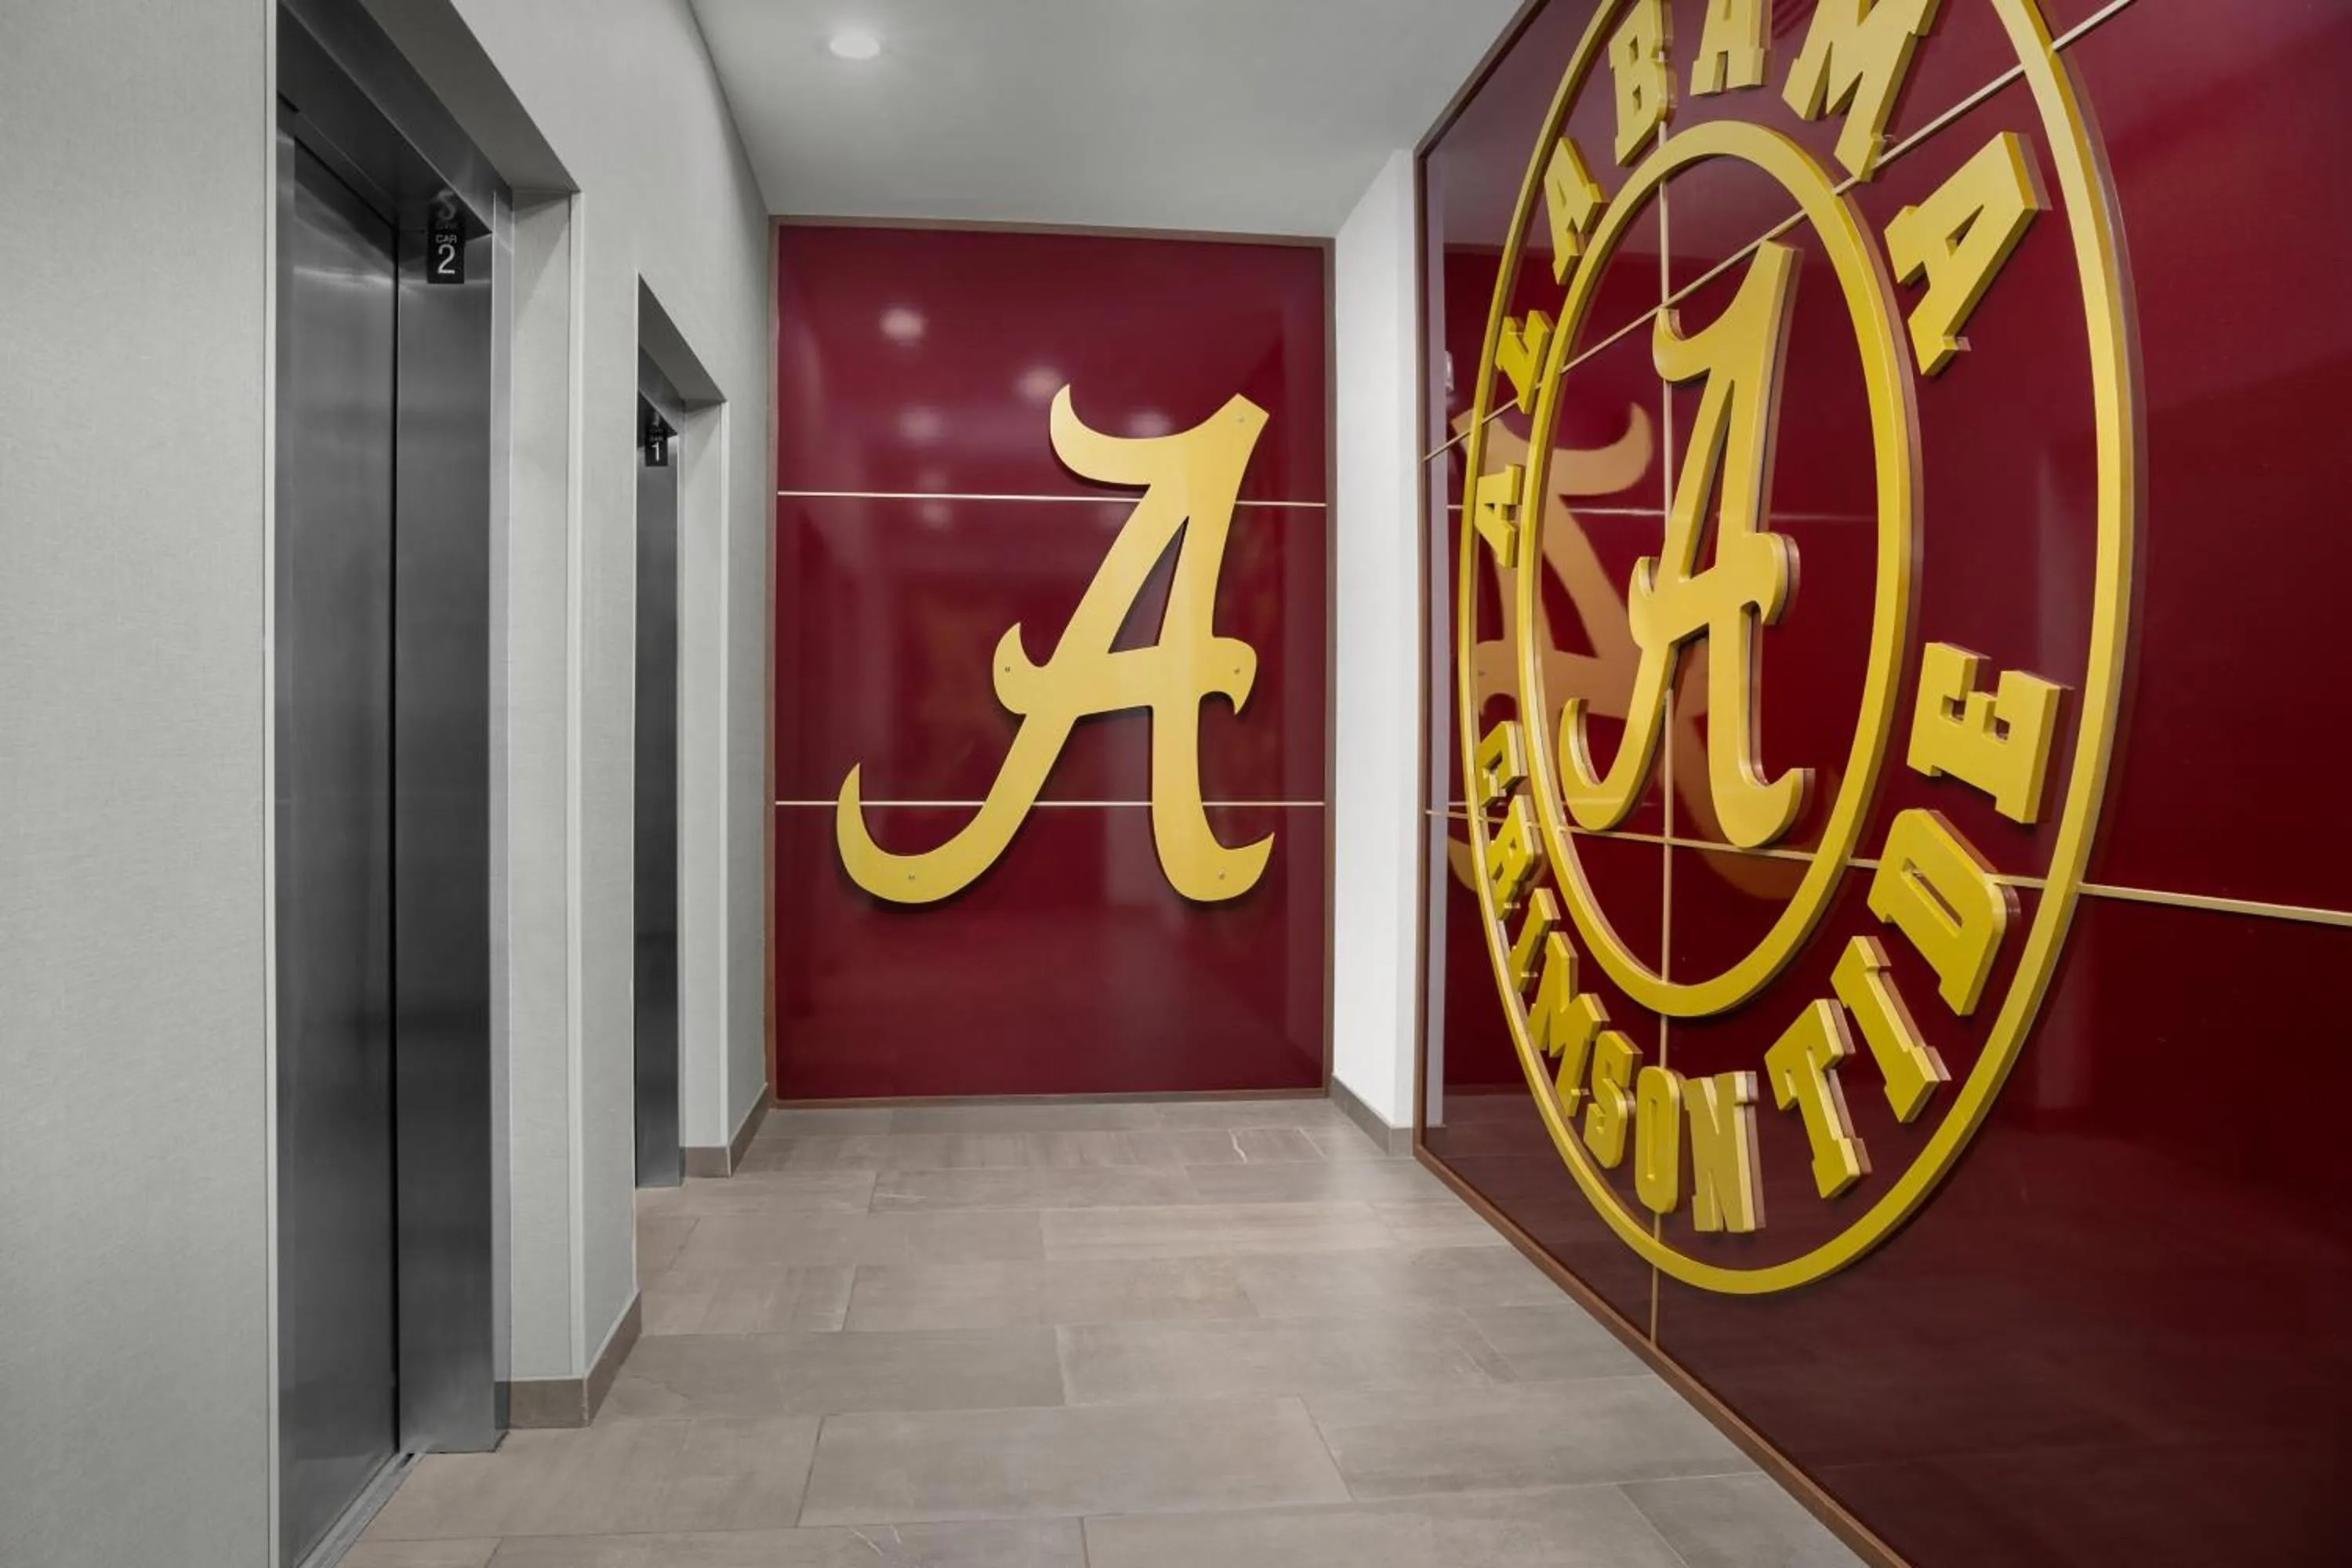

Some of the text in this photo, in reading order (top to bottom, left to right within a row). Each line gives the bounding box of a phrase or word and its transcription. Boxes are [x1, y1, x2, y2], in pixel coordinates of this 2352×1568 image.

[437, 244, 456, 274] 2
[652, 441, 659, 462] 1
[837, 383, 1276, 904] A
[1557, 238, 1813, 848] A
[1475, 643, 2064, 1232] CRIMSON TIDE
